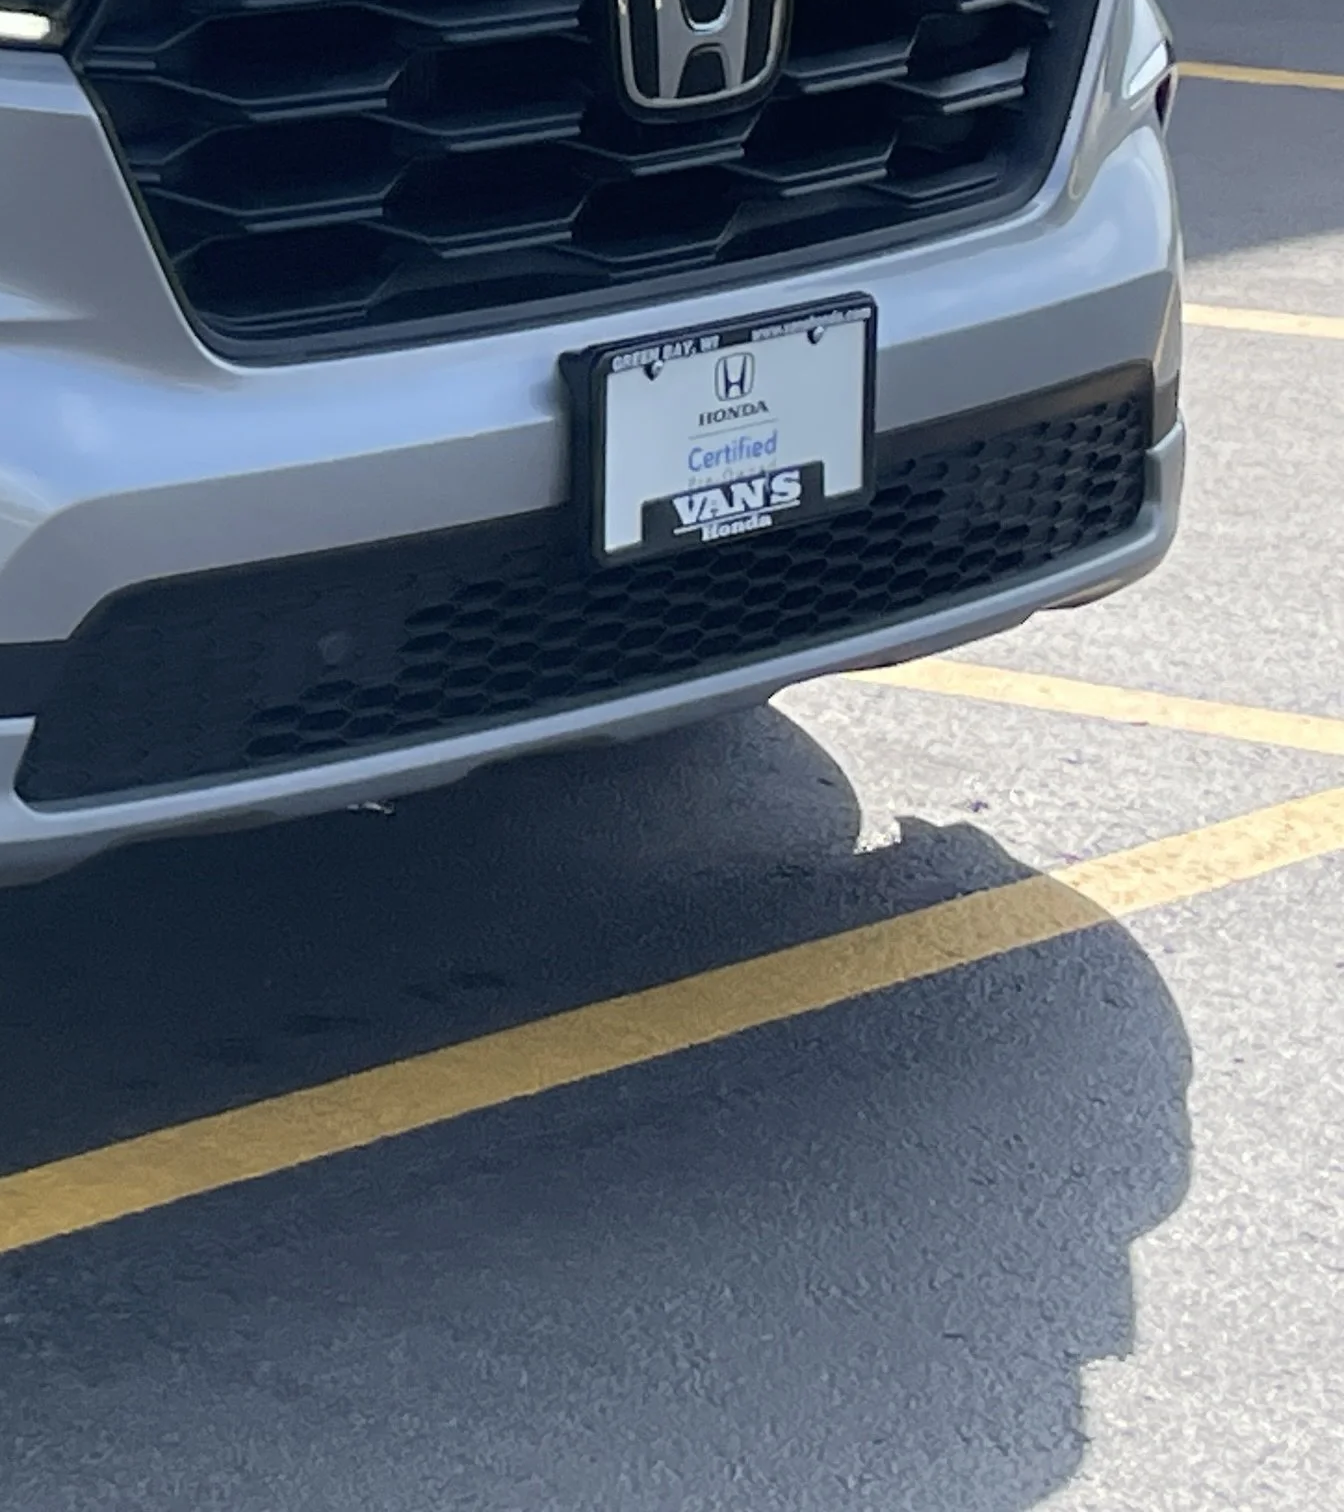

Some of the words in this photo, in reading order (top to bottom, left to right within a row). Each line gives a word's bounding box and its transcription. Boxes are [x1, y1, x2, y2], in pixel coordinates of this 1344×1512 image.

[698, 400, 770, 426] HONDA
[688, 428, 778, 472] Certified
[701, 512, 773, 542] Honda
